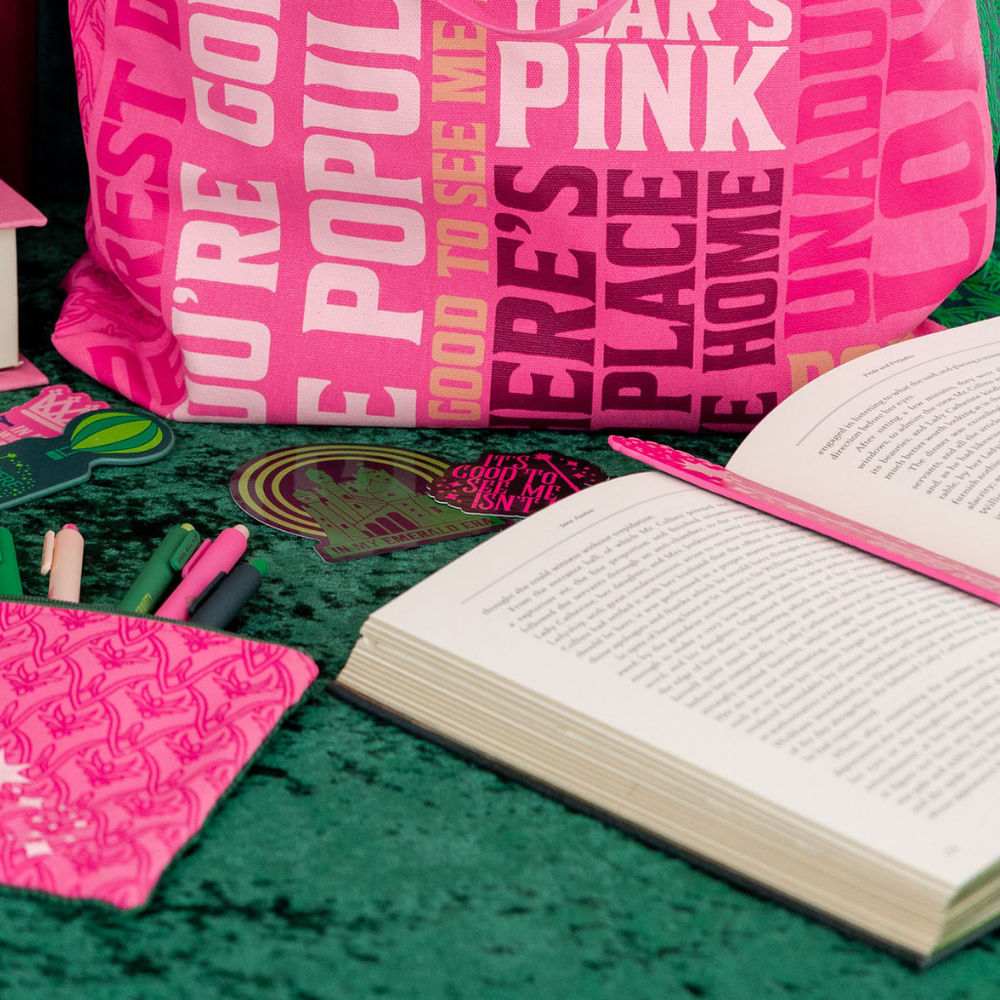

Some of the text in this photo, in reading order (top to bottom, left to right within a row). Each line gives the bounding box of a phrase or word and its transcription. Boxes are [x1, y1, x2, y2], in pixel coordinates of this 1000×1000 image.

[431, 21, 488, 105] ME
[495, 40, 790, 153] PINK
[431, 121, 488, 208] SEE
[437, 221, 489, 278] TO
[703, 168, 784, 373] HOME
[601, 169, 698, 414] PLACE
[427, 295, 487, 422] GOOD
[818, 427, 847, 456] engaged
[830, 430, 862, 461] direction
[858, 412, 884, 432] before
[856, 434, 876, 453] After
[907, 458, 926, 472] The
[925, 438, 950, 458] dinner
[452, 465, 558, 484] GOOD TO
[483, 454, 530, 469] IT'S
[885, 458, 907, 480] much
[901, 440, 927, 460] better
[462, 478, 561, 500] SEE ME
[471, 492, 541, 513] ISN'T
[330, 518, 495, 555] IN MY EMERALD ERA
